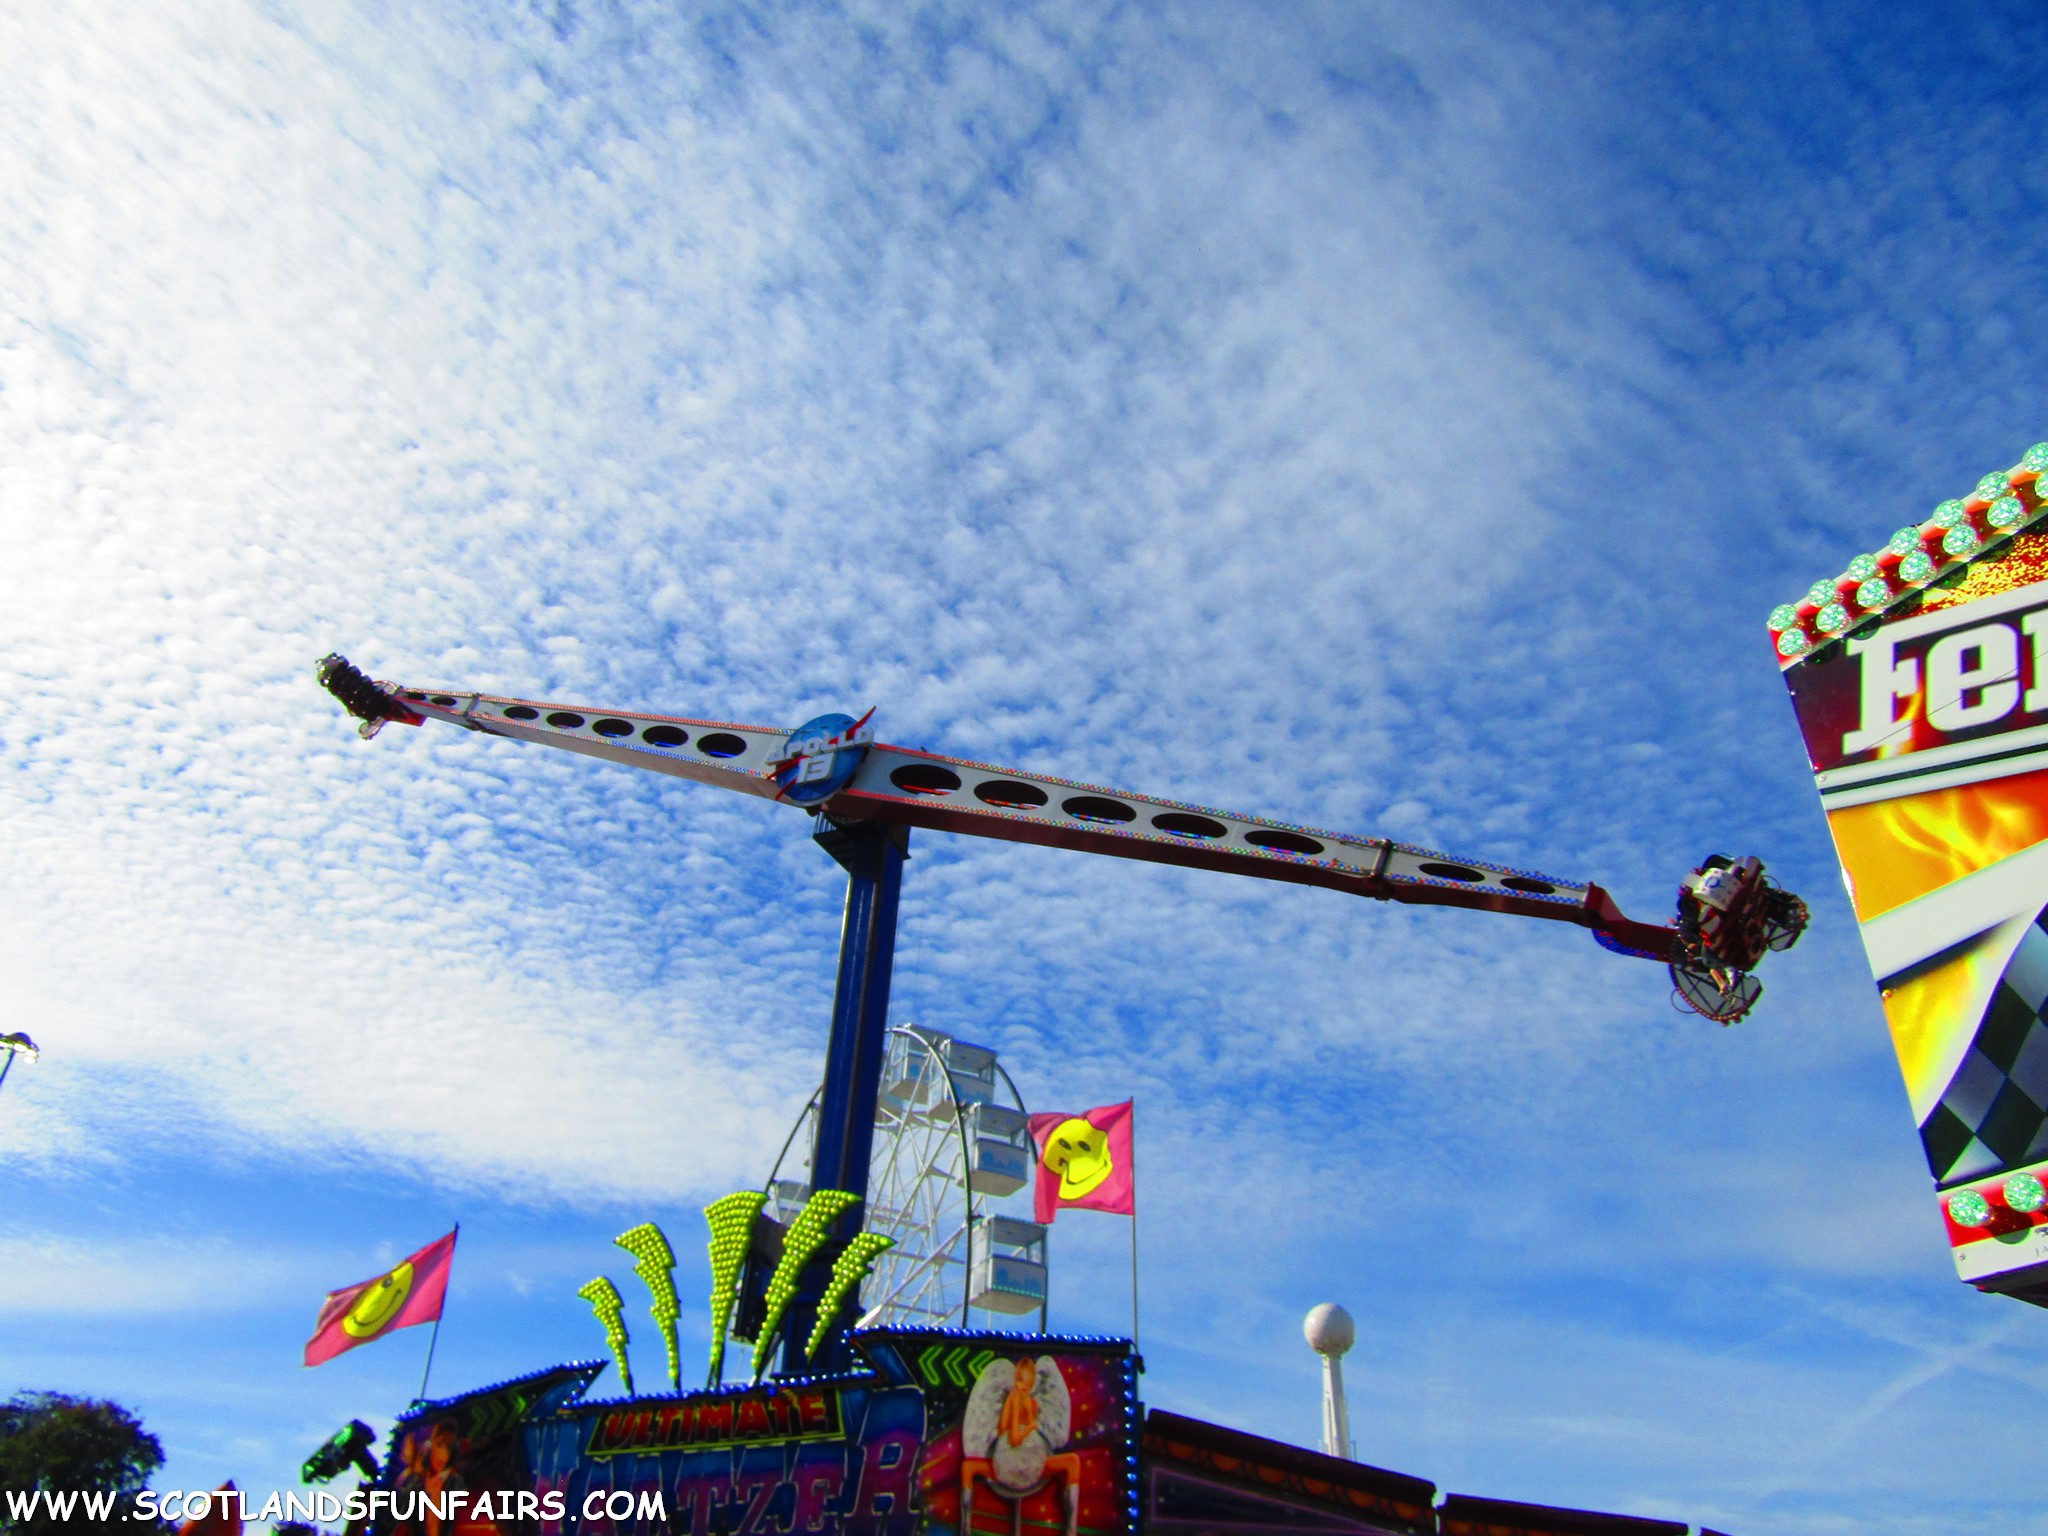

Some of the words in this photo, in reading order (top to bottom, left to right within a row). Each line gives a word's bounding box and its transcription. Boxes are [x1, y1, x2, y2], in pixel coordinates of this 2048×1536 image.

[766, 726, 874, 765] APOLLO
[796, 752, 834, 784] 13
[602, 1388, 829, 1449] ULTIMATE
